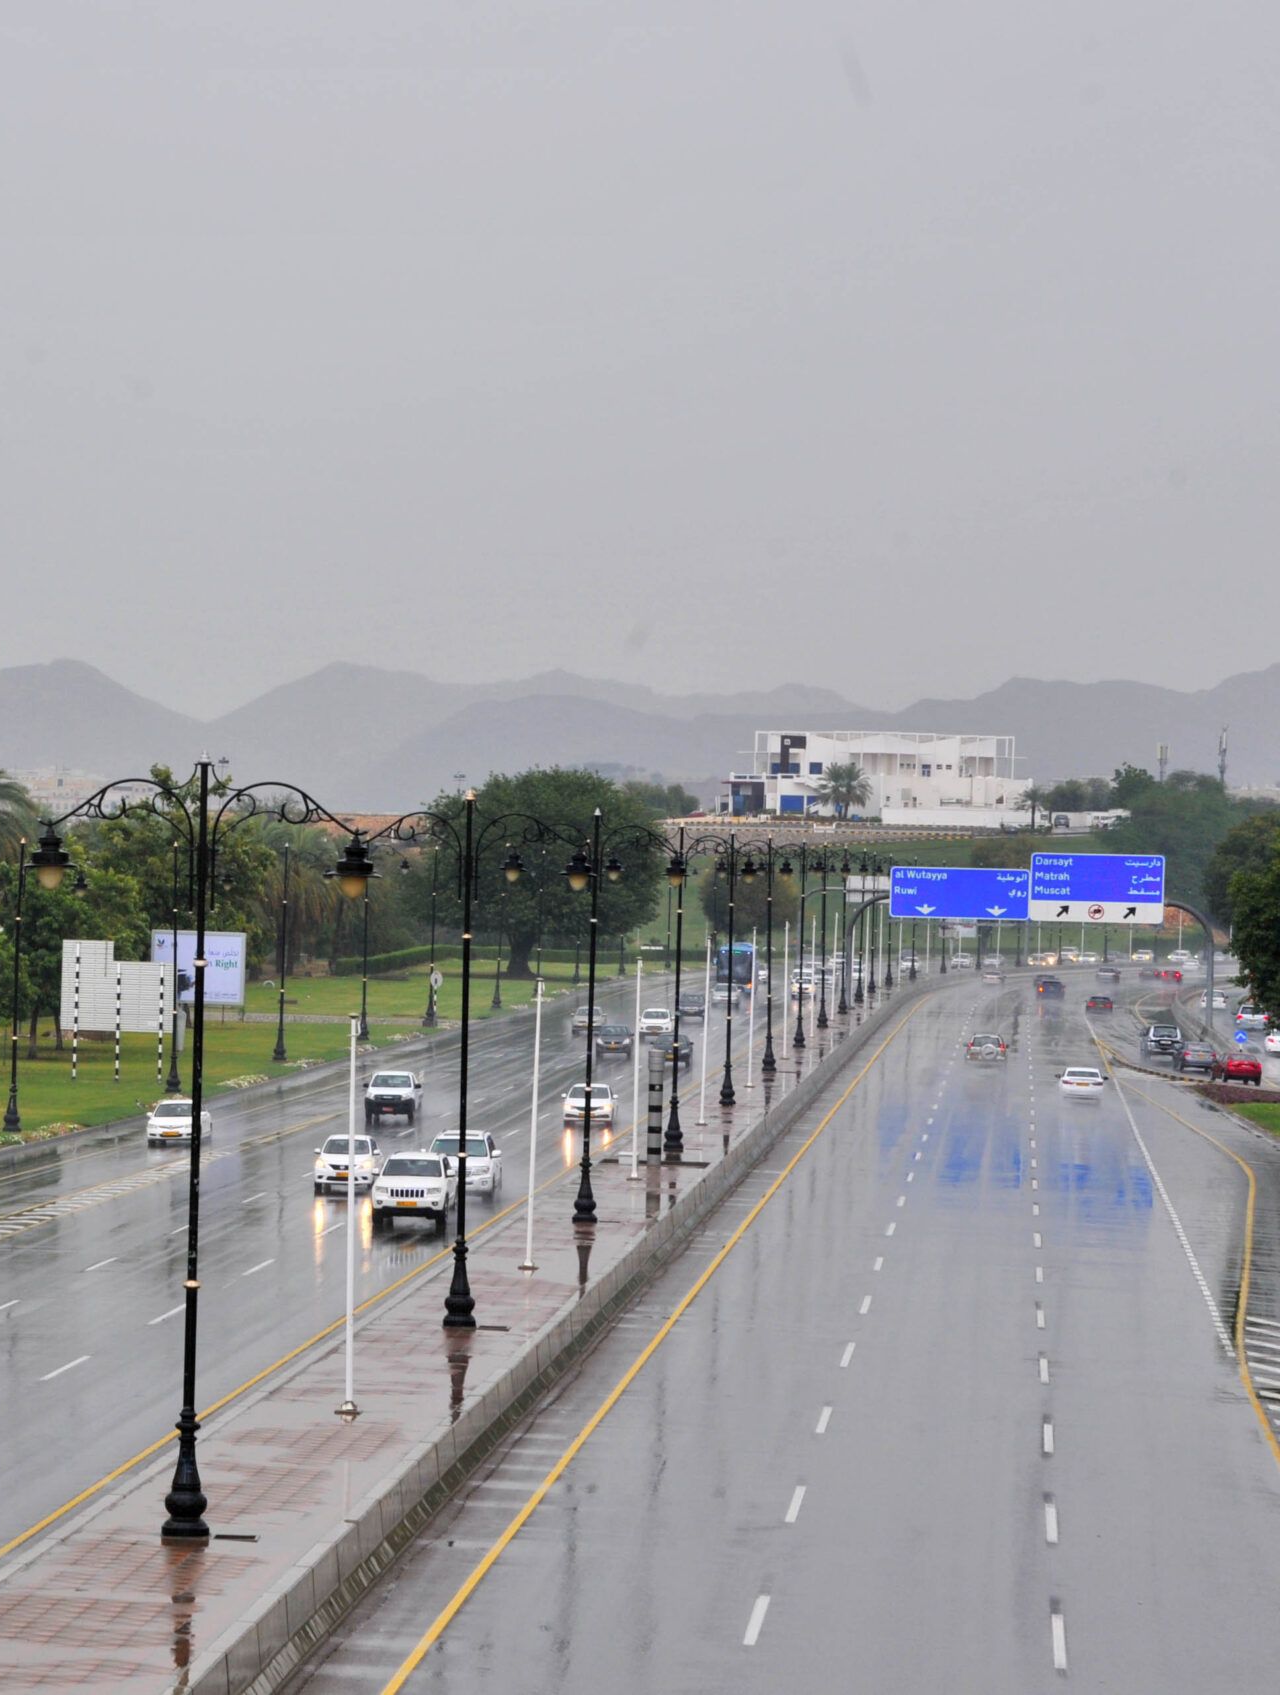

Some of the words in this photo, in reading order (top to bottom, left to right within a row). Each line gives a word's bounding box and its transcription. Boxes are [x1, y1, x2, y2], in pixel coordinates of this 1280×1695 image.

[1035, 857, 1073, 868] Darsayt
[1124, 858, 1161, 868] دارسيت
[895, 870, 905, 879] al
[906, 870, 948, 881] Wutayya
[1035, 872, 1070, 881] Matrah
[1131, 874, 1161, 884] مطرح
[894, 886, 918, 895] Ruwi
[1008, 890, 1027, 898] روي
[1034, 886, 1071, 895] Muscat
[1127, 887, 1160, 896] مسقط
[215, 959, 238, 971] Right
